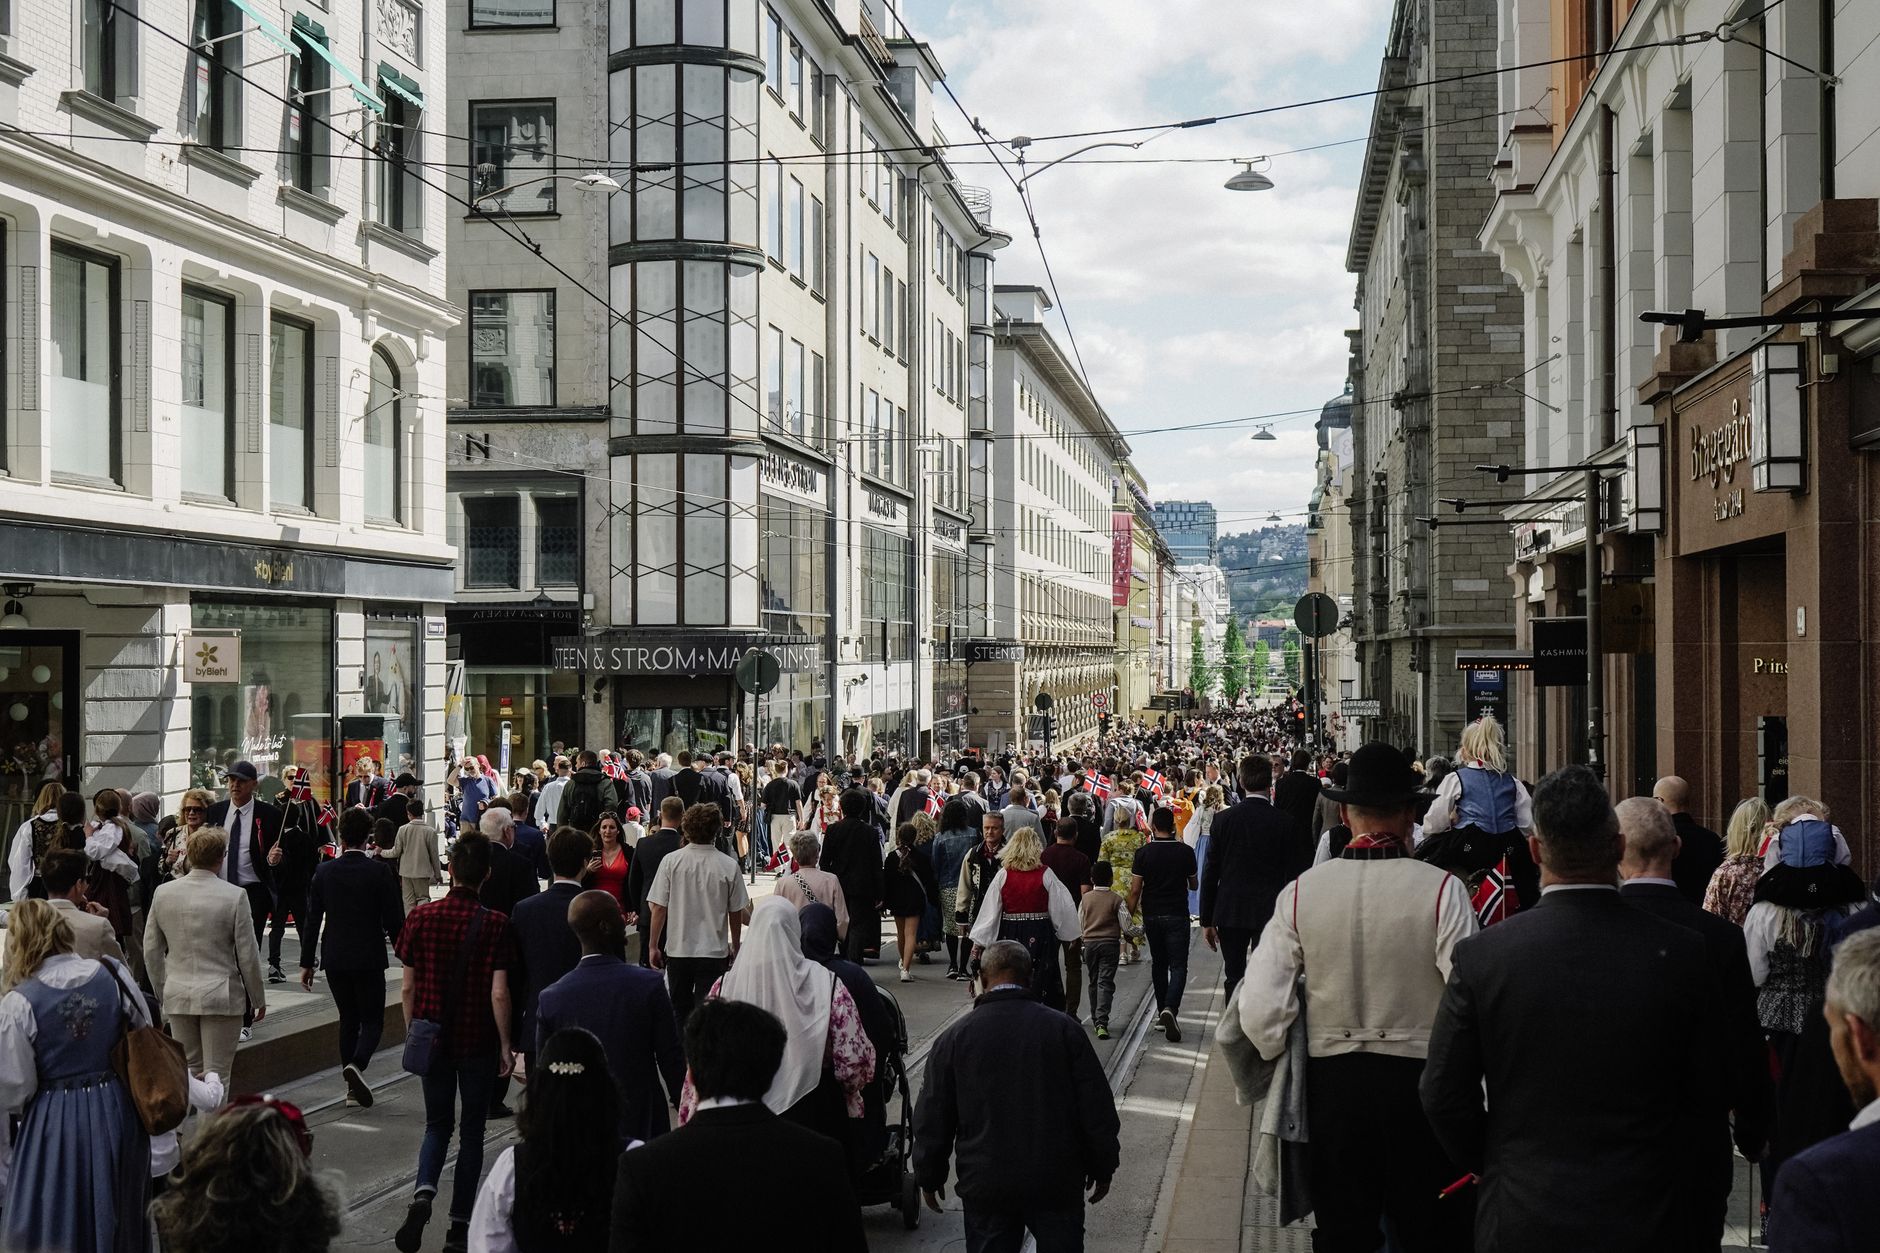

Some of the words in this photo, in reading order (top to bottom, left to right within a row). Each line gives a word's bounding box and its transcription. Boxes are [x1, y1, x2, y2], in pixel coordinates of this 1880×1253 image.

[554, 647, 587, 670] STEEN
[593, 648, 605, 670] &
[611, 645, 696, 671] STRØM
[707, 646, 799, 669] MASIN
[974, 646, 1009, 660] STEEN
[195, 667, 228, 677] byBiehl
